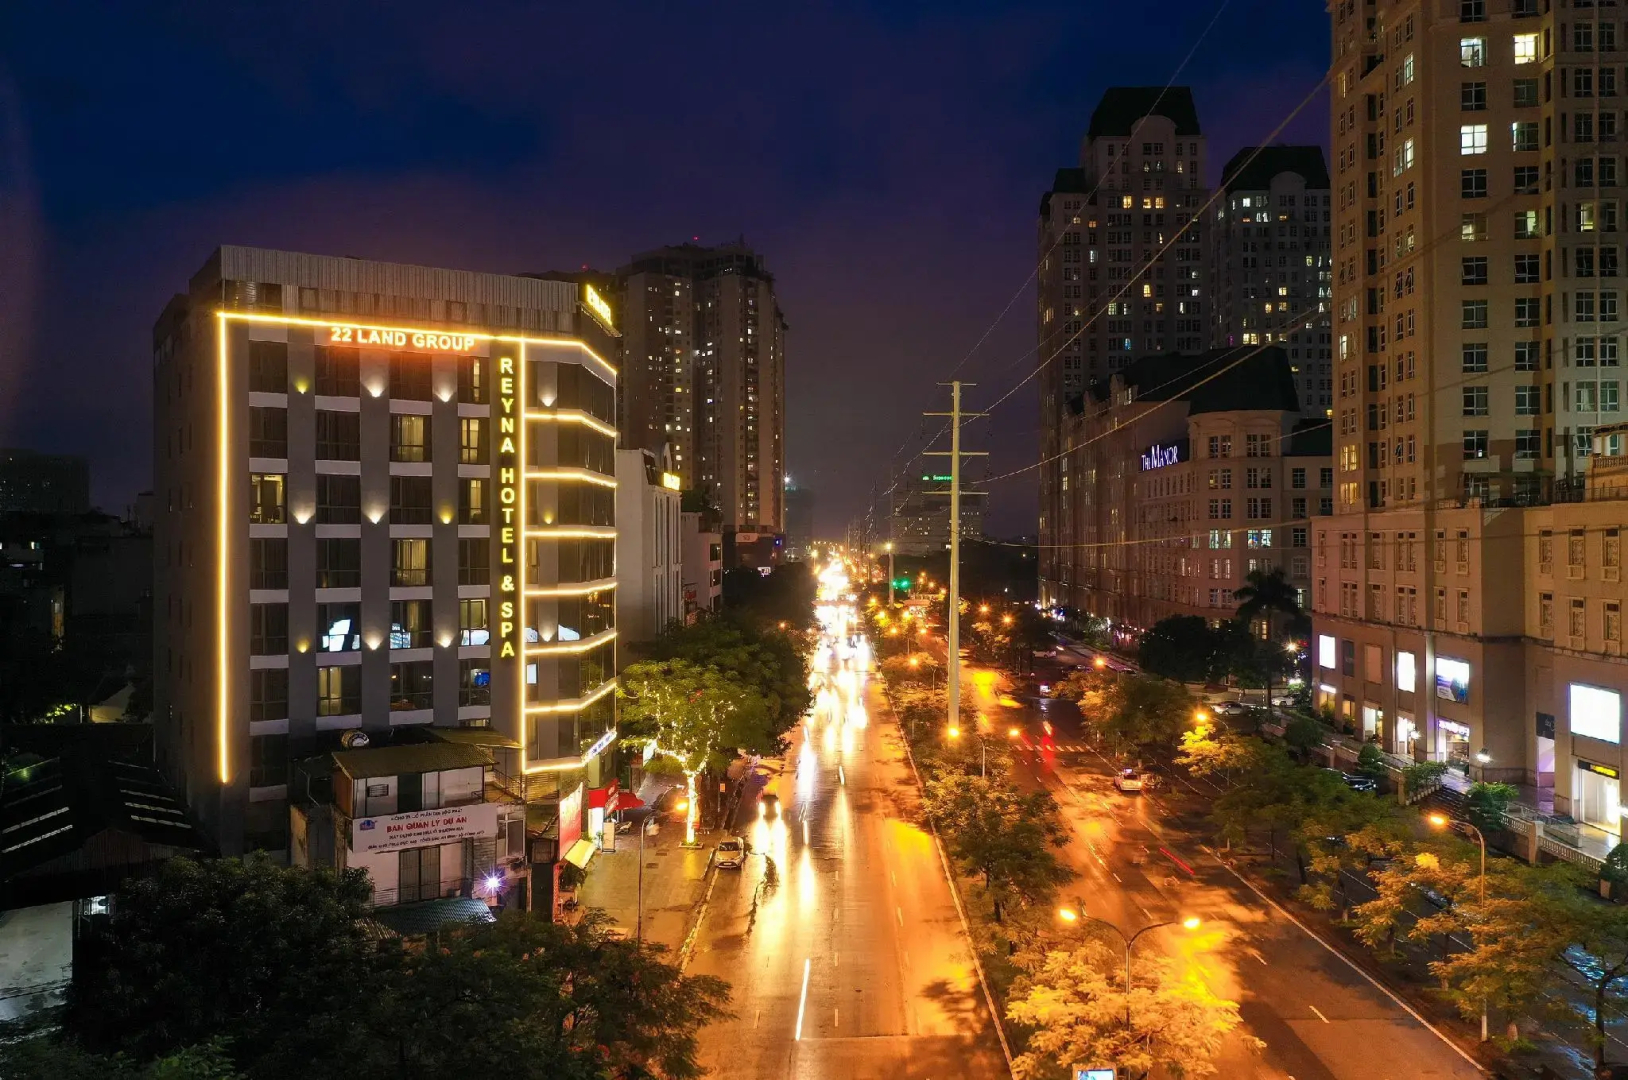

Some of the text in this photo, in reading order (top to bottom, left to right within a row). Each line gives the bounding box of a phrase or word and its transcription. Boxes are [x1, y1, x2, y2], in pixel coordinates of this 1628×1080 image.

[331, 327, 475, 350] 22 LAND GROUP
[1141, 444, 1178, 471] THE MANOR
[500, 357, 515, 658] REYNA HOTEL & SPA
[386, 824, 403, 833] BAN
